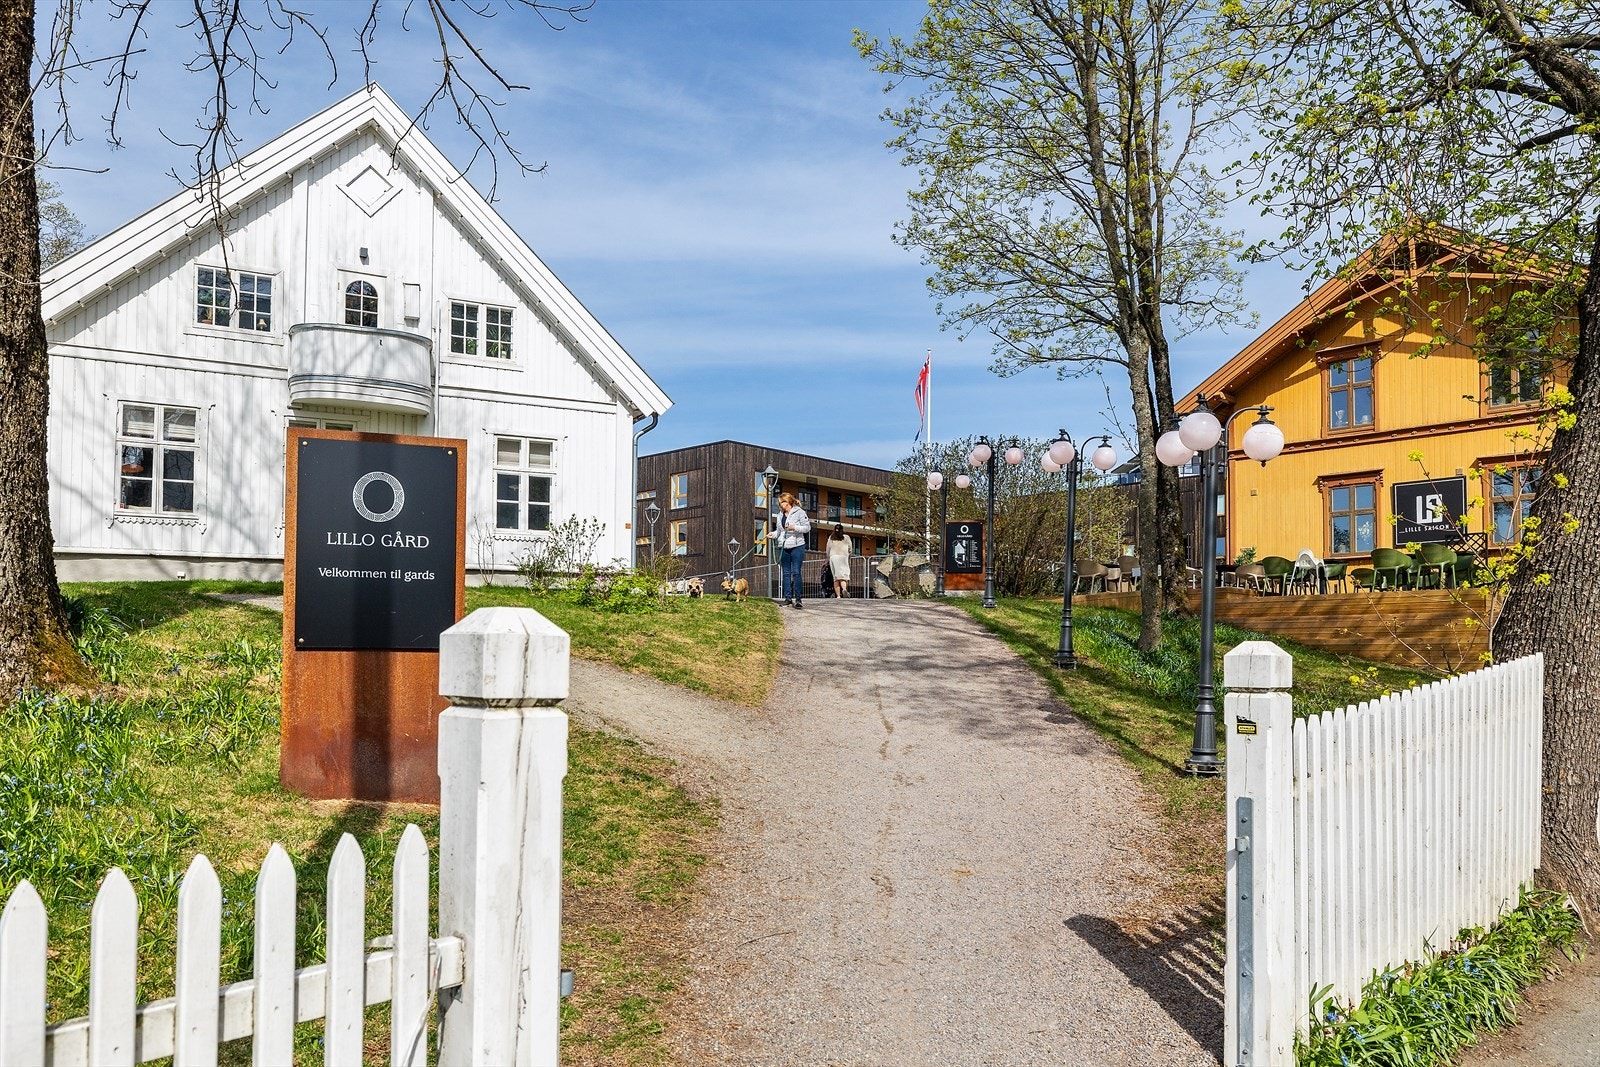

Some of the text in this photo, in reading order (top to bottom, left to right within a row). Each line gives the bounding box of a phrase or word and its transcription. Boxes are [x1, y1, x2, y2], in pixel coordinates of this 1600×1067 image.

[326, 530, 430, 549] LILLO GÅRD
[318, 567, 435, 582] Velkommen til gards
